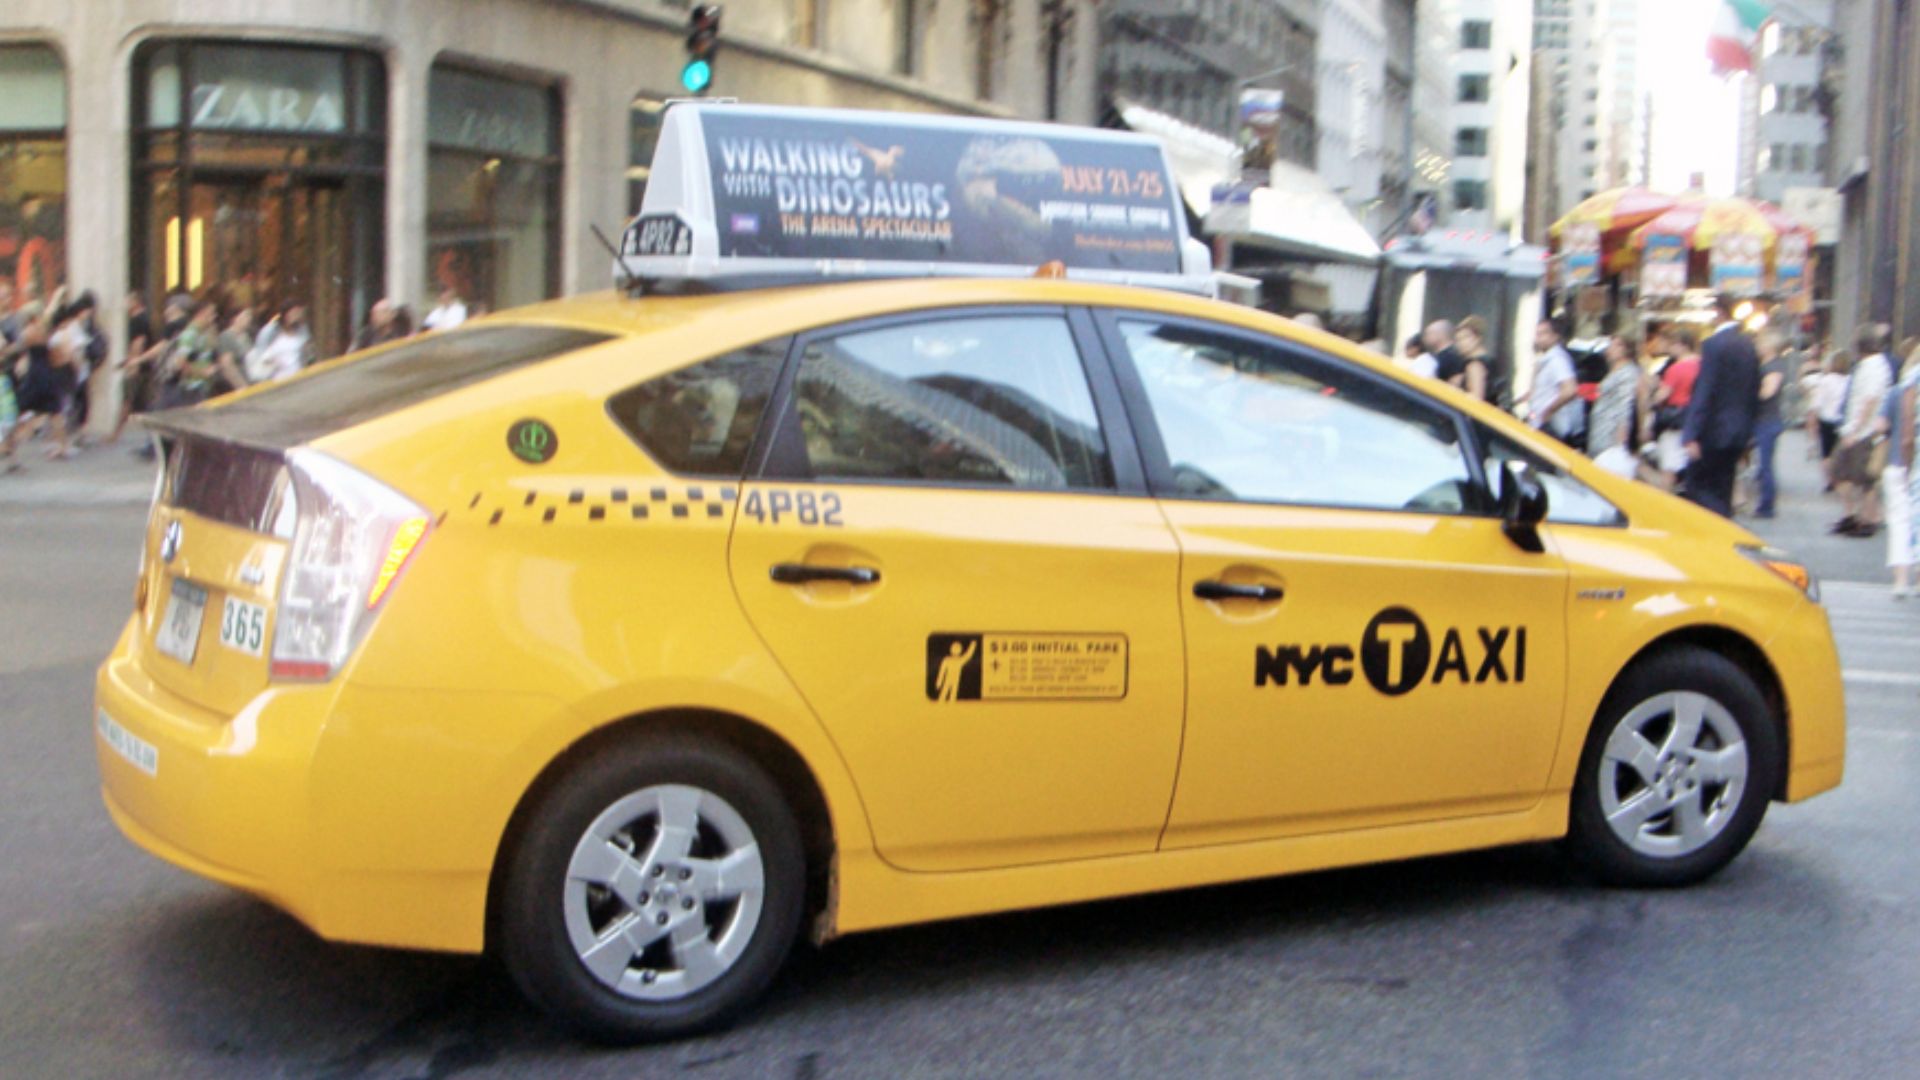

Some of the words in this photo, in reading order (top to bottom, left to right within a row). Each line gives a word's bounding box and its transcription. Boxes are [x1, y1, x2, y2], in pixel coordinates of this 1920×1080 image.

[191, 83, 345, 132] ZARA
[720, 137, 863, 178] WALKING
[1062, 164, 1104, 192] JULY
[724, 173, 771, 196] WITH
[775, 177, 950, 219] DINOSAURS
[781, 214, 806, 236] THE
[811, 216, 858, 238] ARENA
[861, 218, 953, 241] SPECTACULAR
[744, 489, 844, 526] 4P82
[222, 599, 263, 651] 365
[1255, 645, 1354, 688] NYC
[1373, 621, 1526, 689] TAXI
